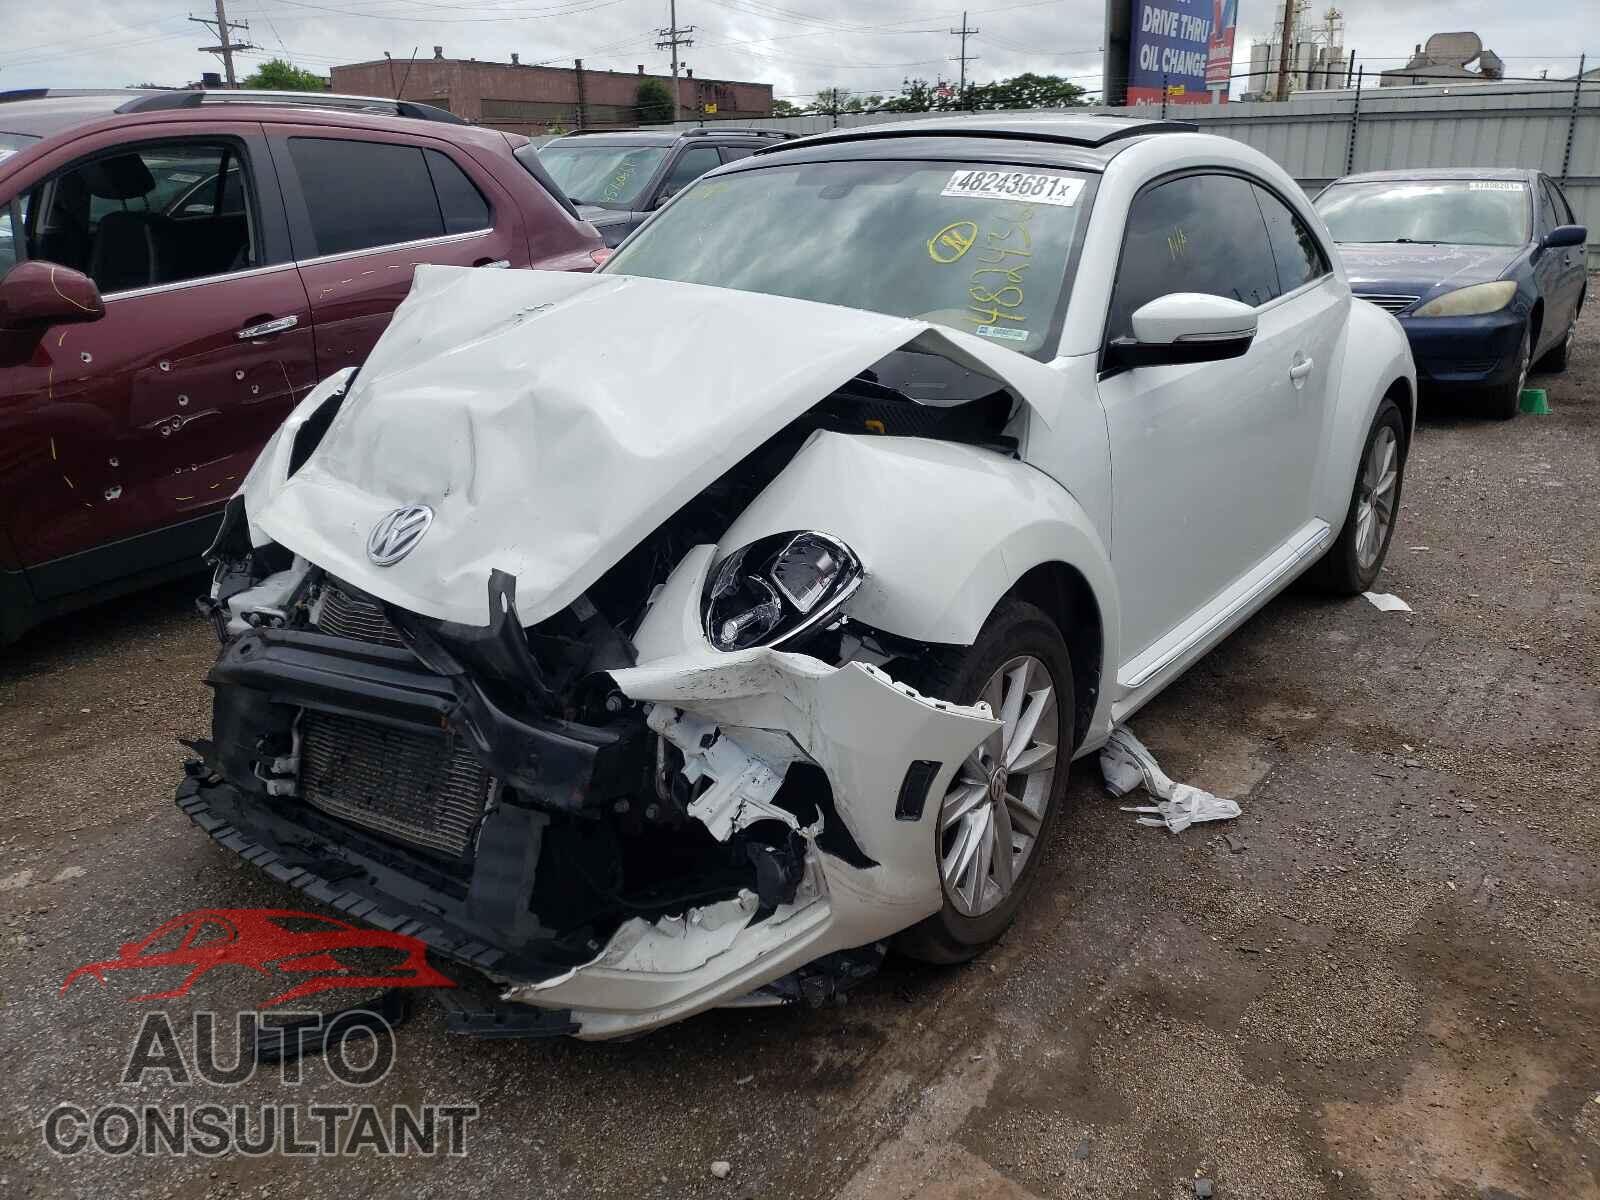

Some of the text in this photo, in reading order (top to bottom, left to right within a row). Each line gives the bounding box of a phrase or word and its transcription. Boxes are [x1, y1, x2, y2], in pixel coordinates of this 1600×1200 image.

[1142, 6, 1210, 43] DRIVE THRU
[1140, 44, 1160, 71] OIL
[1162, 47, 1207, 76] CHANGE
